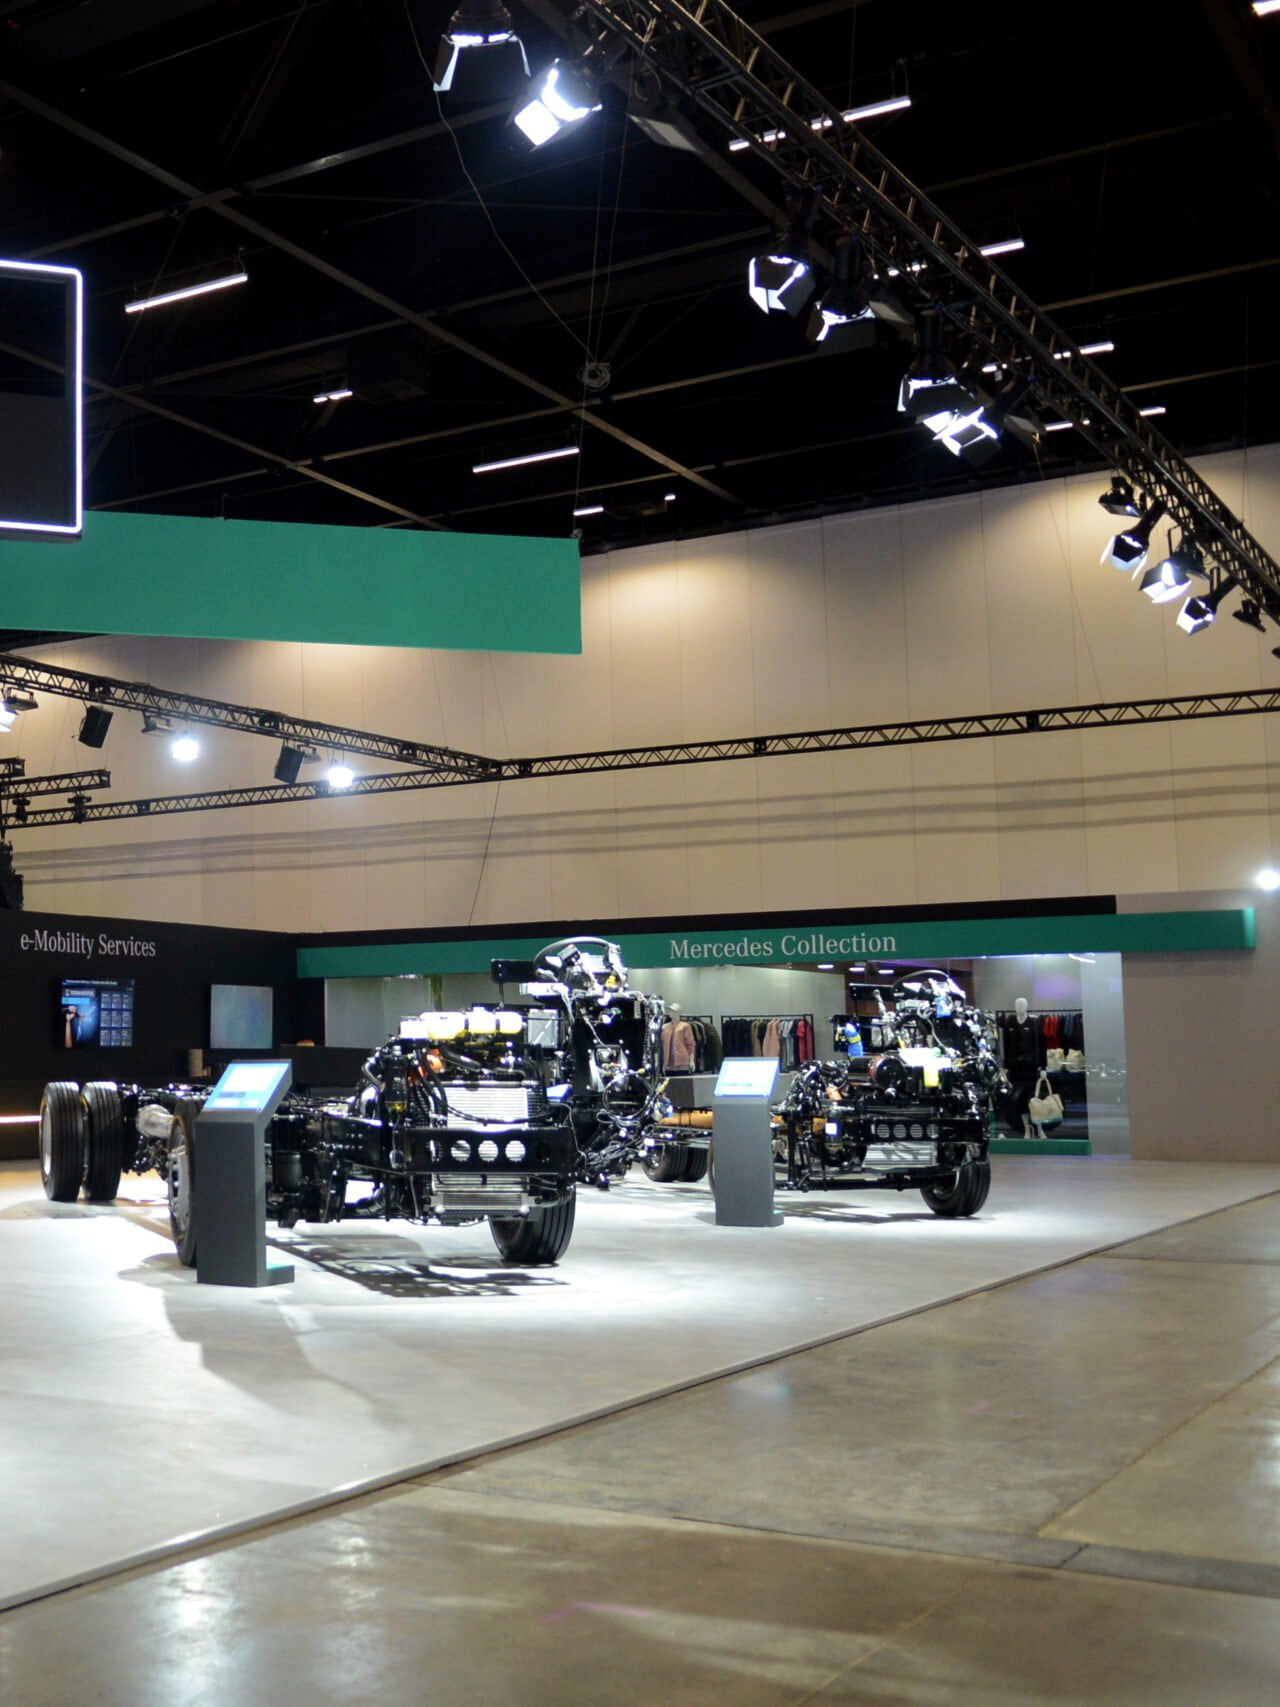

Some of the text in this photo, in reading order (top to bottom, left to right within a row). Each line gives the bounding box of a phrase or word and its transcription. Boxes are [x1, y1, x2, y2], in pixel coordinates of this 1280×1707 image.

[20, 929, 156, 959] e-Mobility Services
[670, 932, 897, 960] Mercedes Collection
